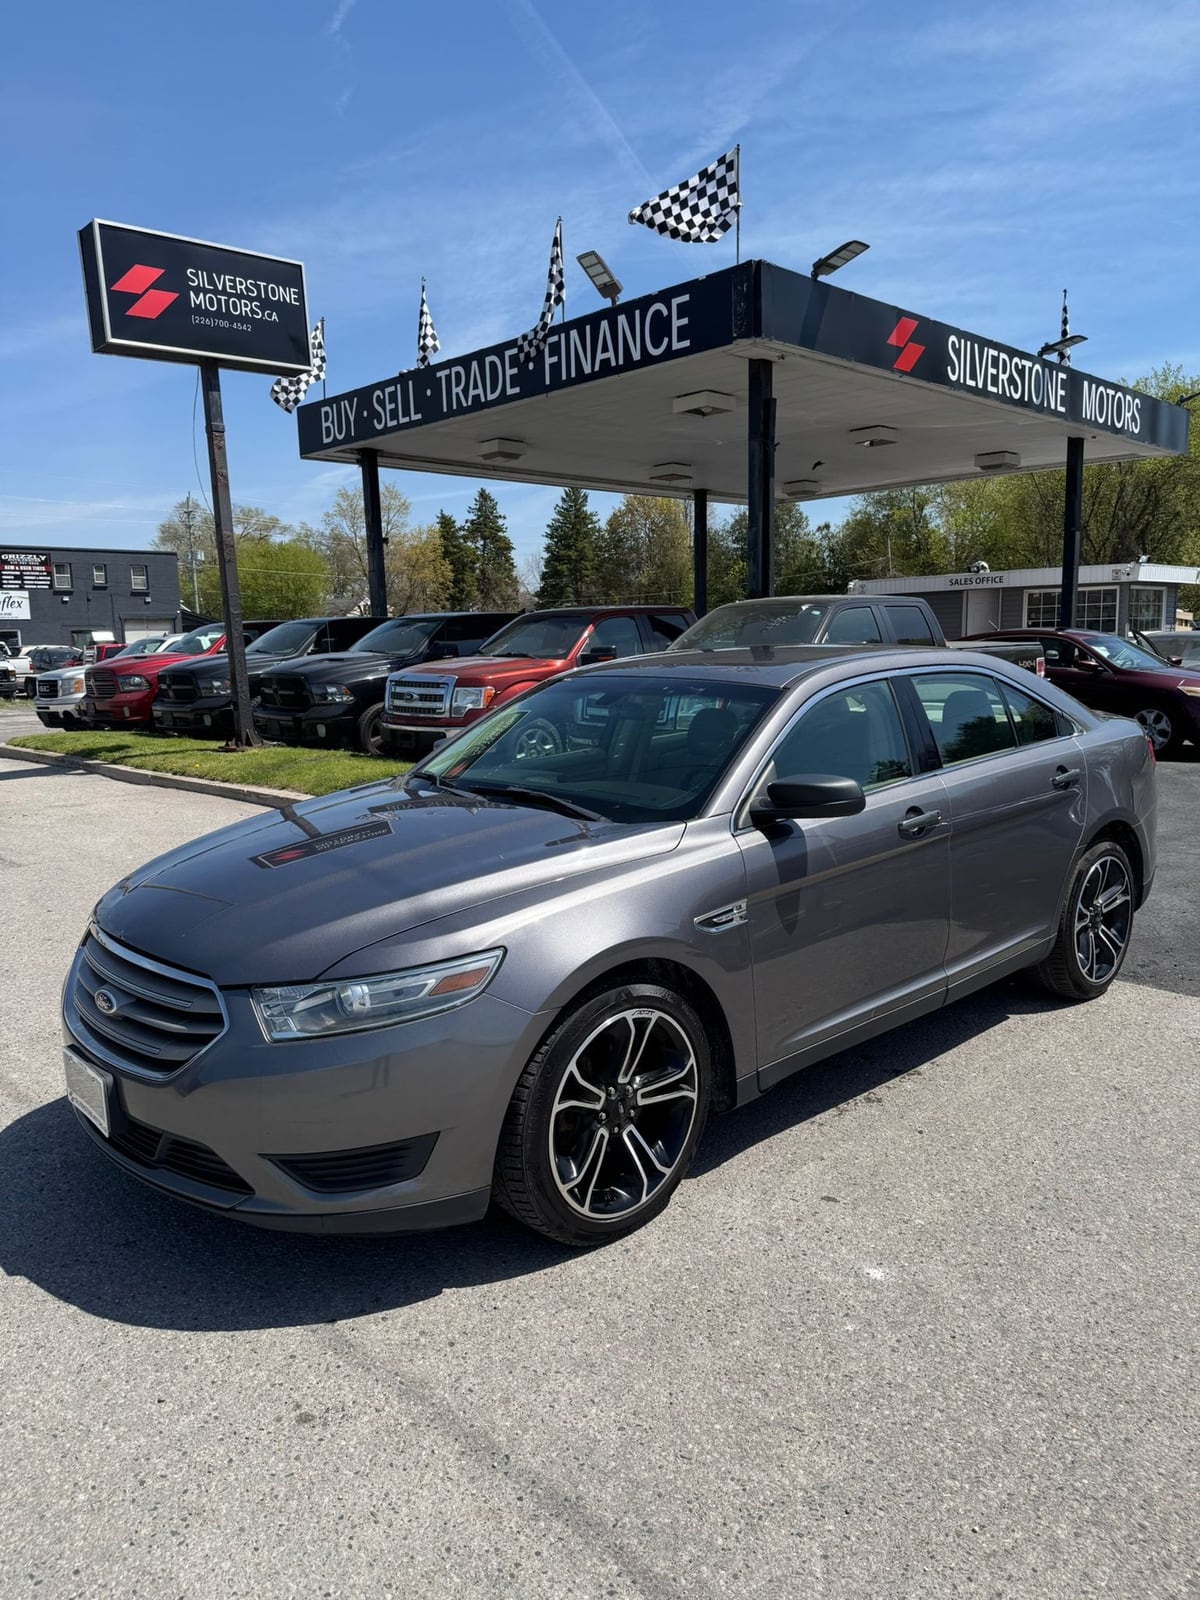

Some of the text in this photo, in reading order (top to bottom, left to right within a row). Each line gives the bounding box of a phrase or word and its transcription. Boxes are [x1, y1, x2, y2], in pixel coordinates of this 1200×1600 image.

[187, 268, 300, 305] SILVERSTONE
[190, 290, 279, 322] MOTORS.CA
[191, 315, 252, 331] (226)700-4542
[320, 294, 690, 444] BUY SELL TRADE FINANCE
[947, 335, 1141, 434] SILVERSTONE MOTORS
[949, 575, 1004, 586] SALES OFFICE
[0, 595, 23, 611] flex
